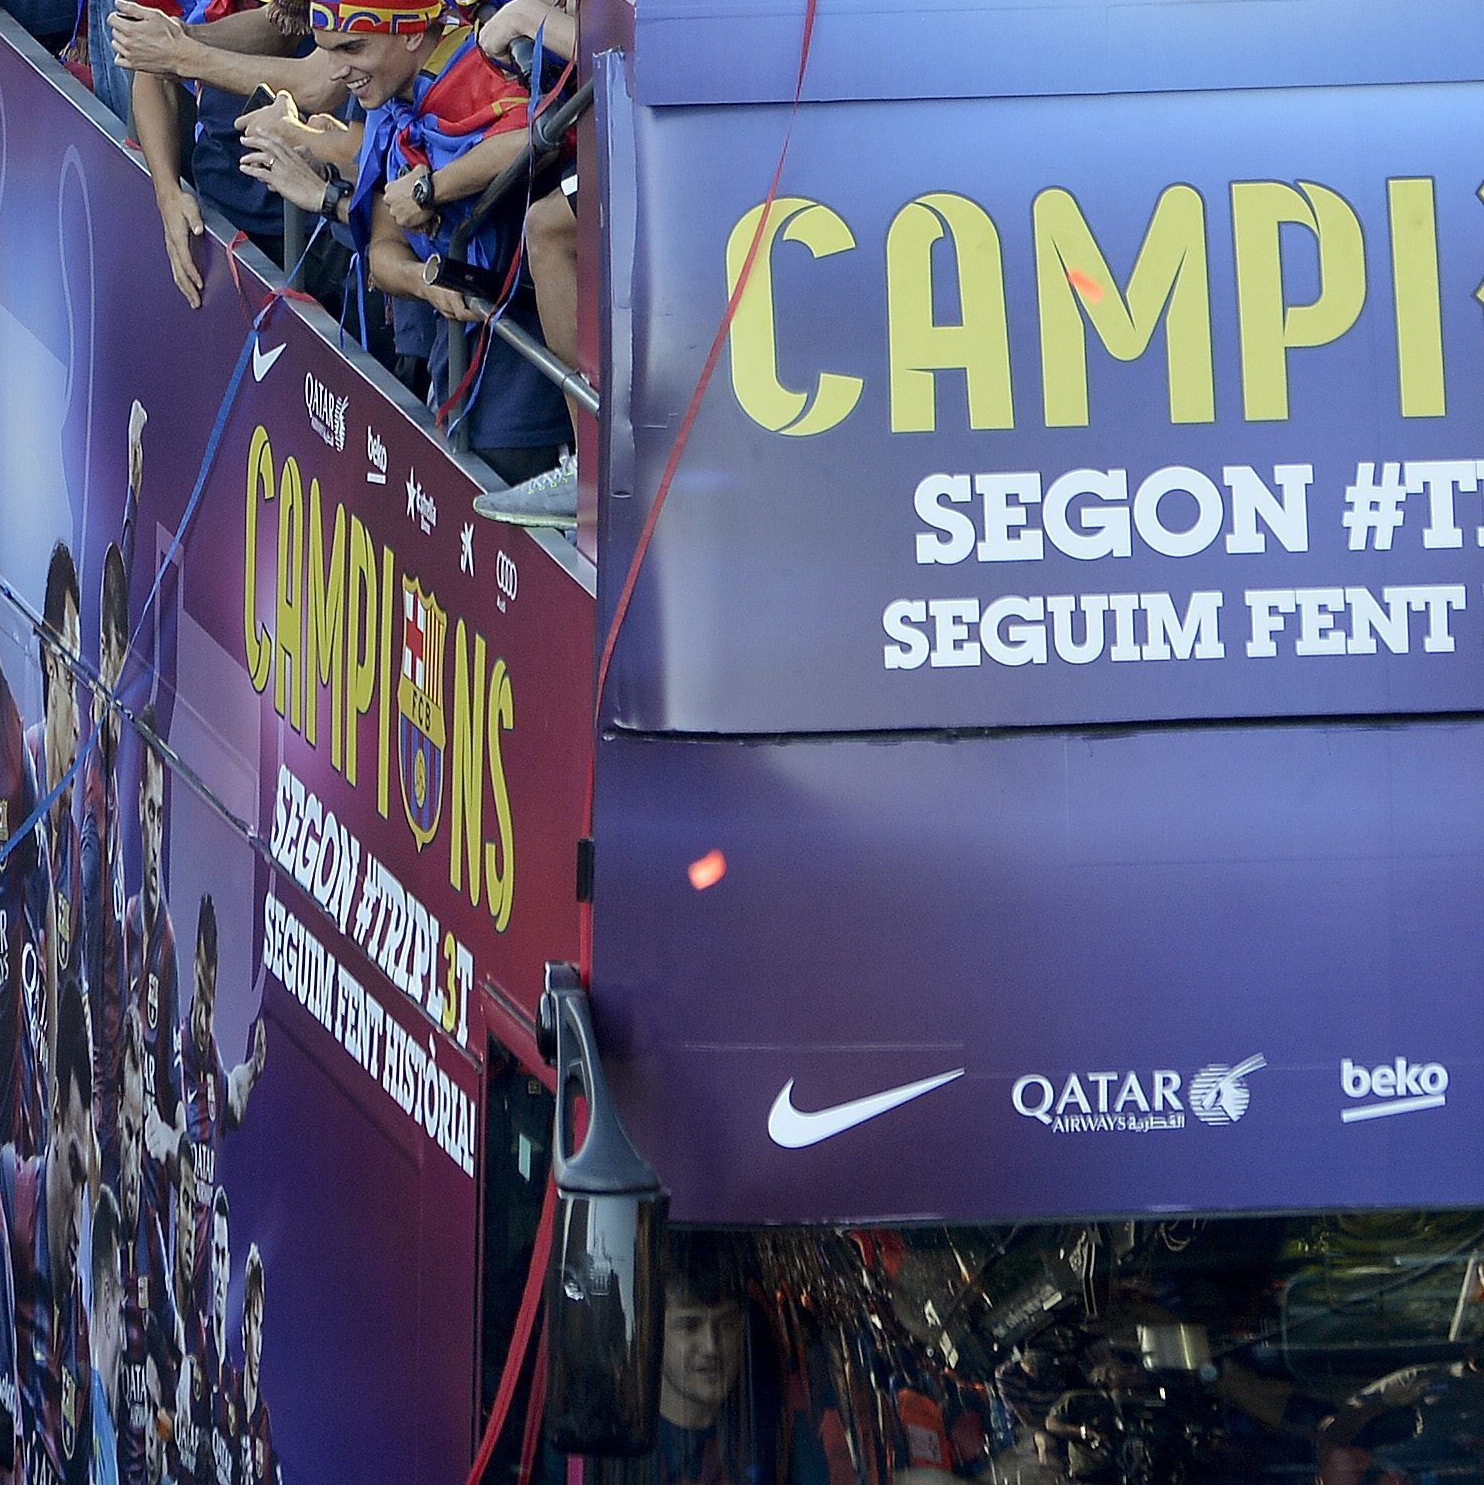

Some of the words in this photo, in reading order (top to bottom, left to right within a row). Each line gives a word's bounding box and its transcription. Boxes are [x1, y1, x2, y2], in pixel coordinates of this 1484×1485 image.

[304, 372, 335, 431] QATAR
[915, 463, 1314, 566] SEGON
[882, 587, 1226, 671] SEGUIM
[1247, 582, 1467, 660] FENT
[243, 423, 515, 934] CAMPINS
[411, 688, 432, 733] FCB
[269, 764, 360, 934] SEGON
[353, 852, 474, 1049] #TRIPL3T
[263, 890, 336, 1035] SEGUIM
[335, 963, 386, 1081] FENT
[381, 1014, 476, 1178] HISTÒRIA!
[1012, 1069, 1183, 1125] QATAR
[1343, 1056, 1449, 1099] beko
[1052, 1115, 1127, 1132] AIRWAYS
